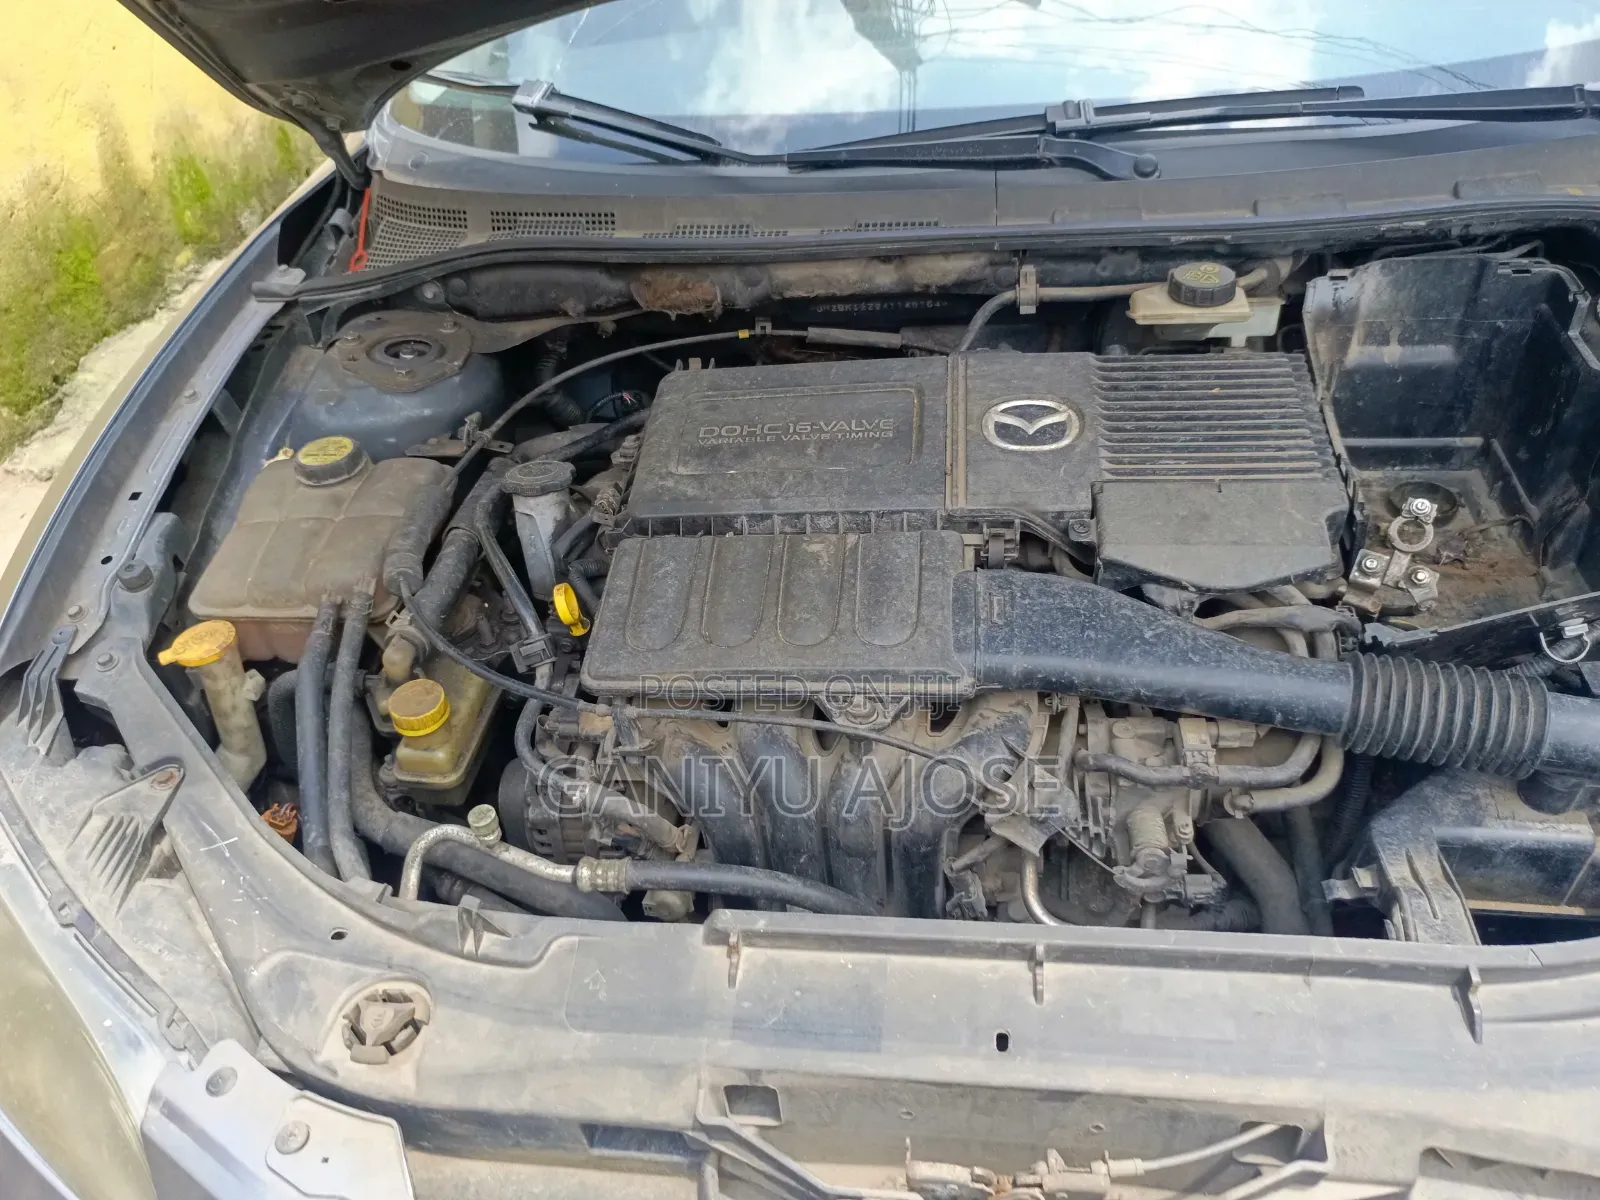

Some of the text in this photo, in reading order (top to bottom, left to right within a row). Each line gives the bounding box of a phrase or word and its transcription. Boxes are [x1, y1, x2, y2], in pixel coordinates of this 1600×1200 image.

[699, 418, 895, 438] DOHC 16-VALVE
[698, 430, 894, 445] VARIABLE VALVE TIMING
